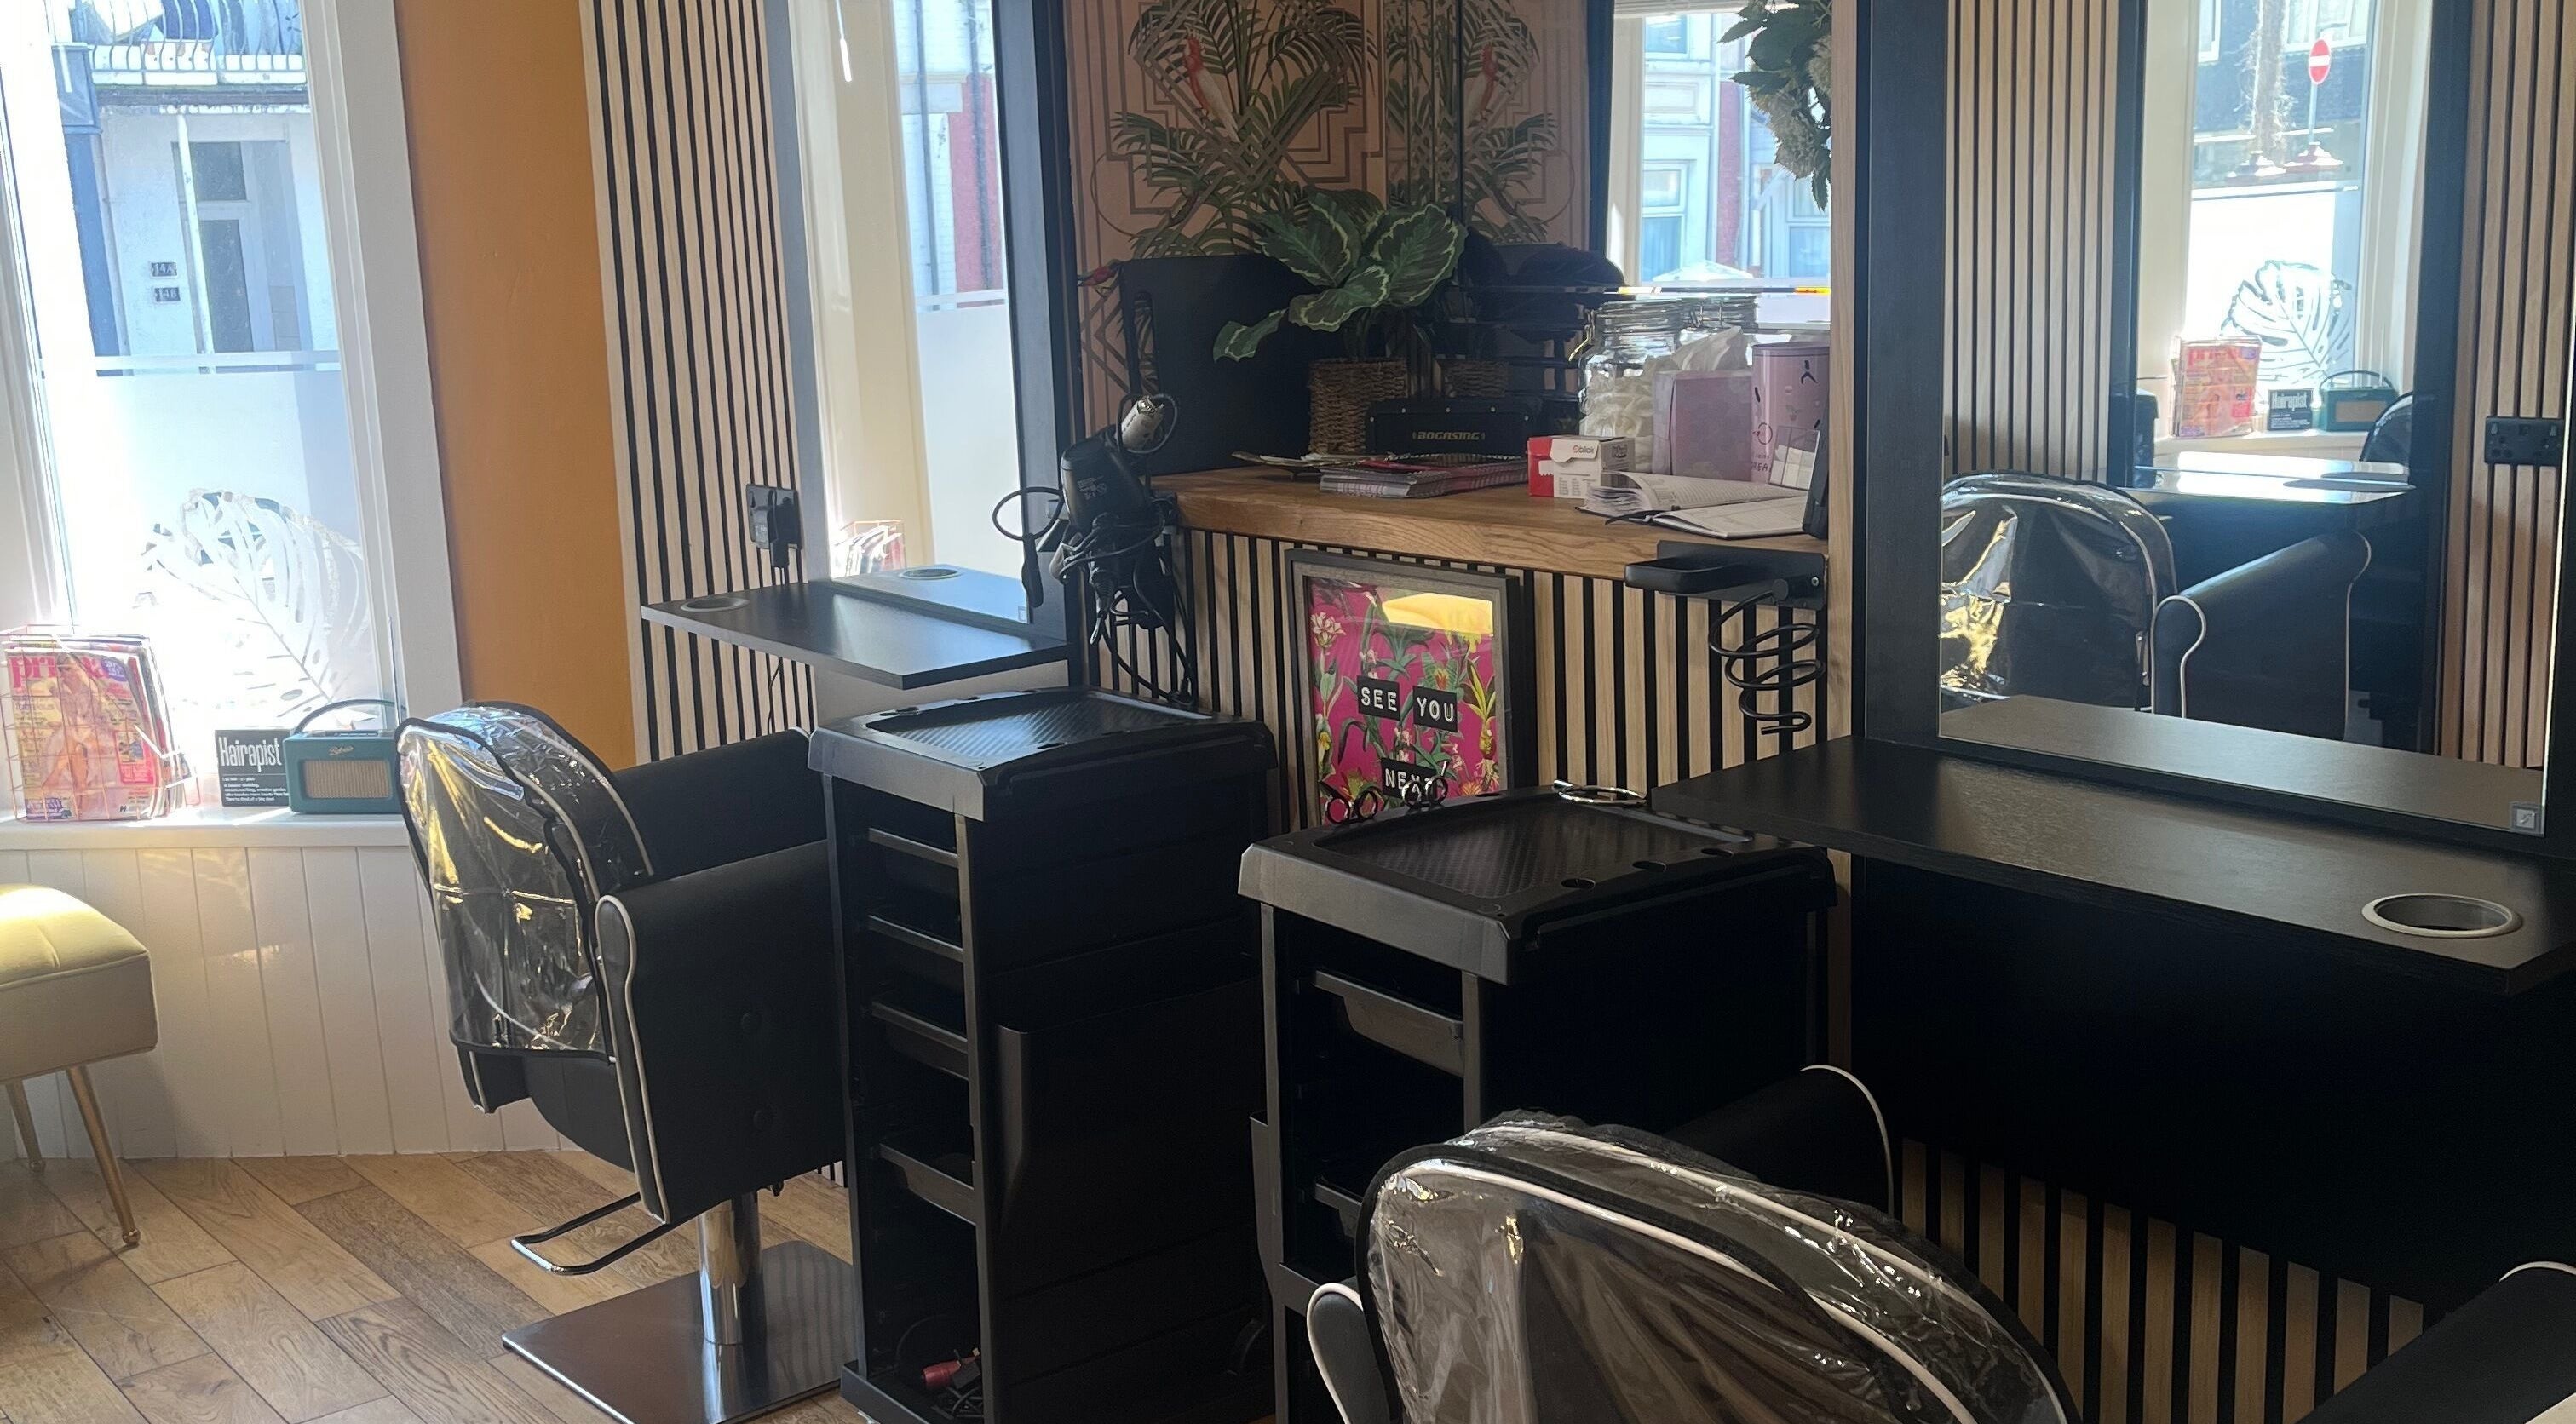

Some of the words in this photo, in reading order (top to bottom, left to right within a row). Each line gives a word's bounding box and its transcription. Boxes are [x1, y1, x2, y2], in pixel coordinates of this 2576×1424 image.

[1360, 686, 1399, 713] SEE
[1416, 696, 1455, 723] YOU
[218, 736, 282, 772] Hairapist
[1384, 767, 1436, 799] NEX
